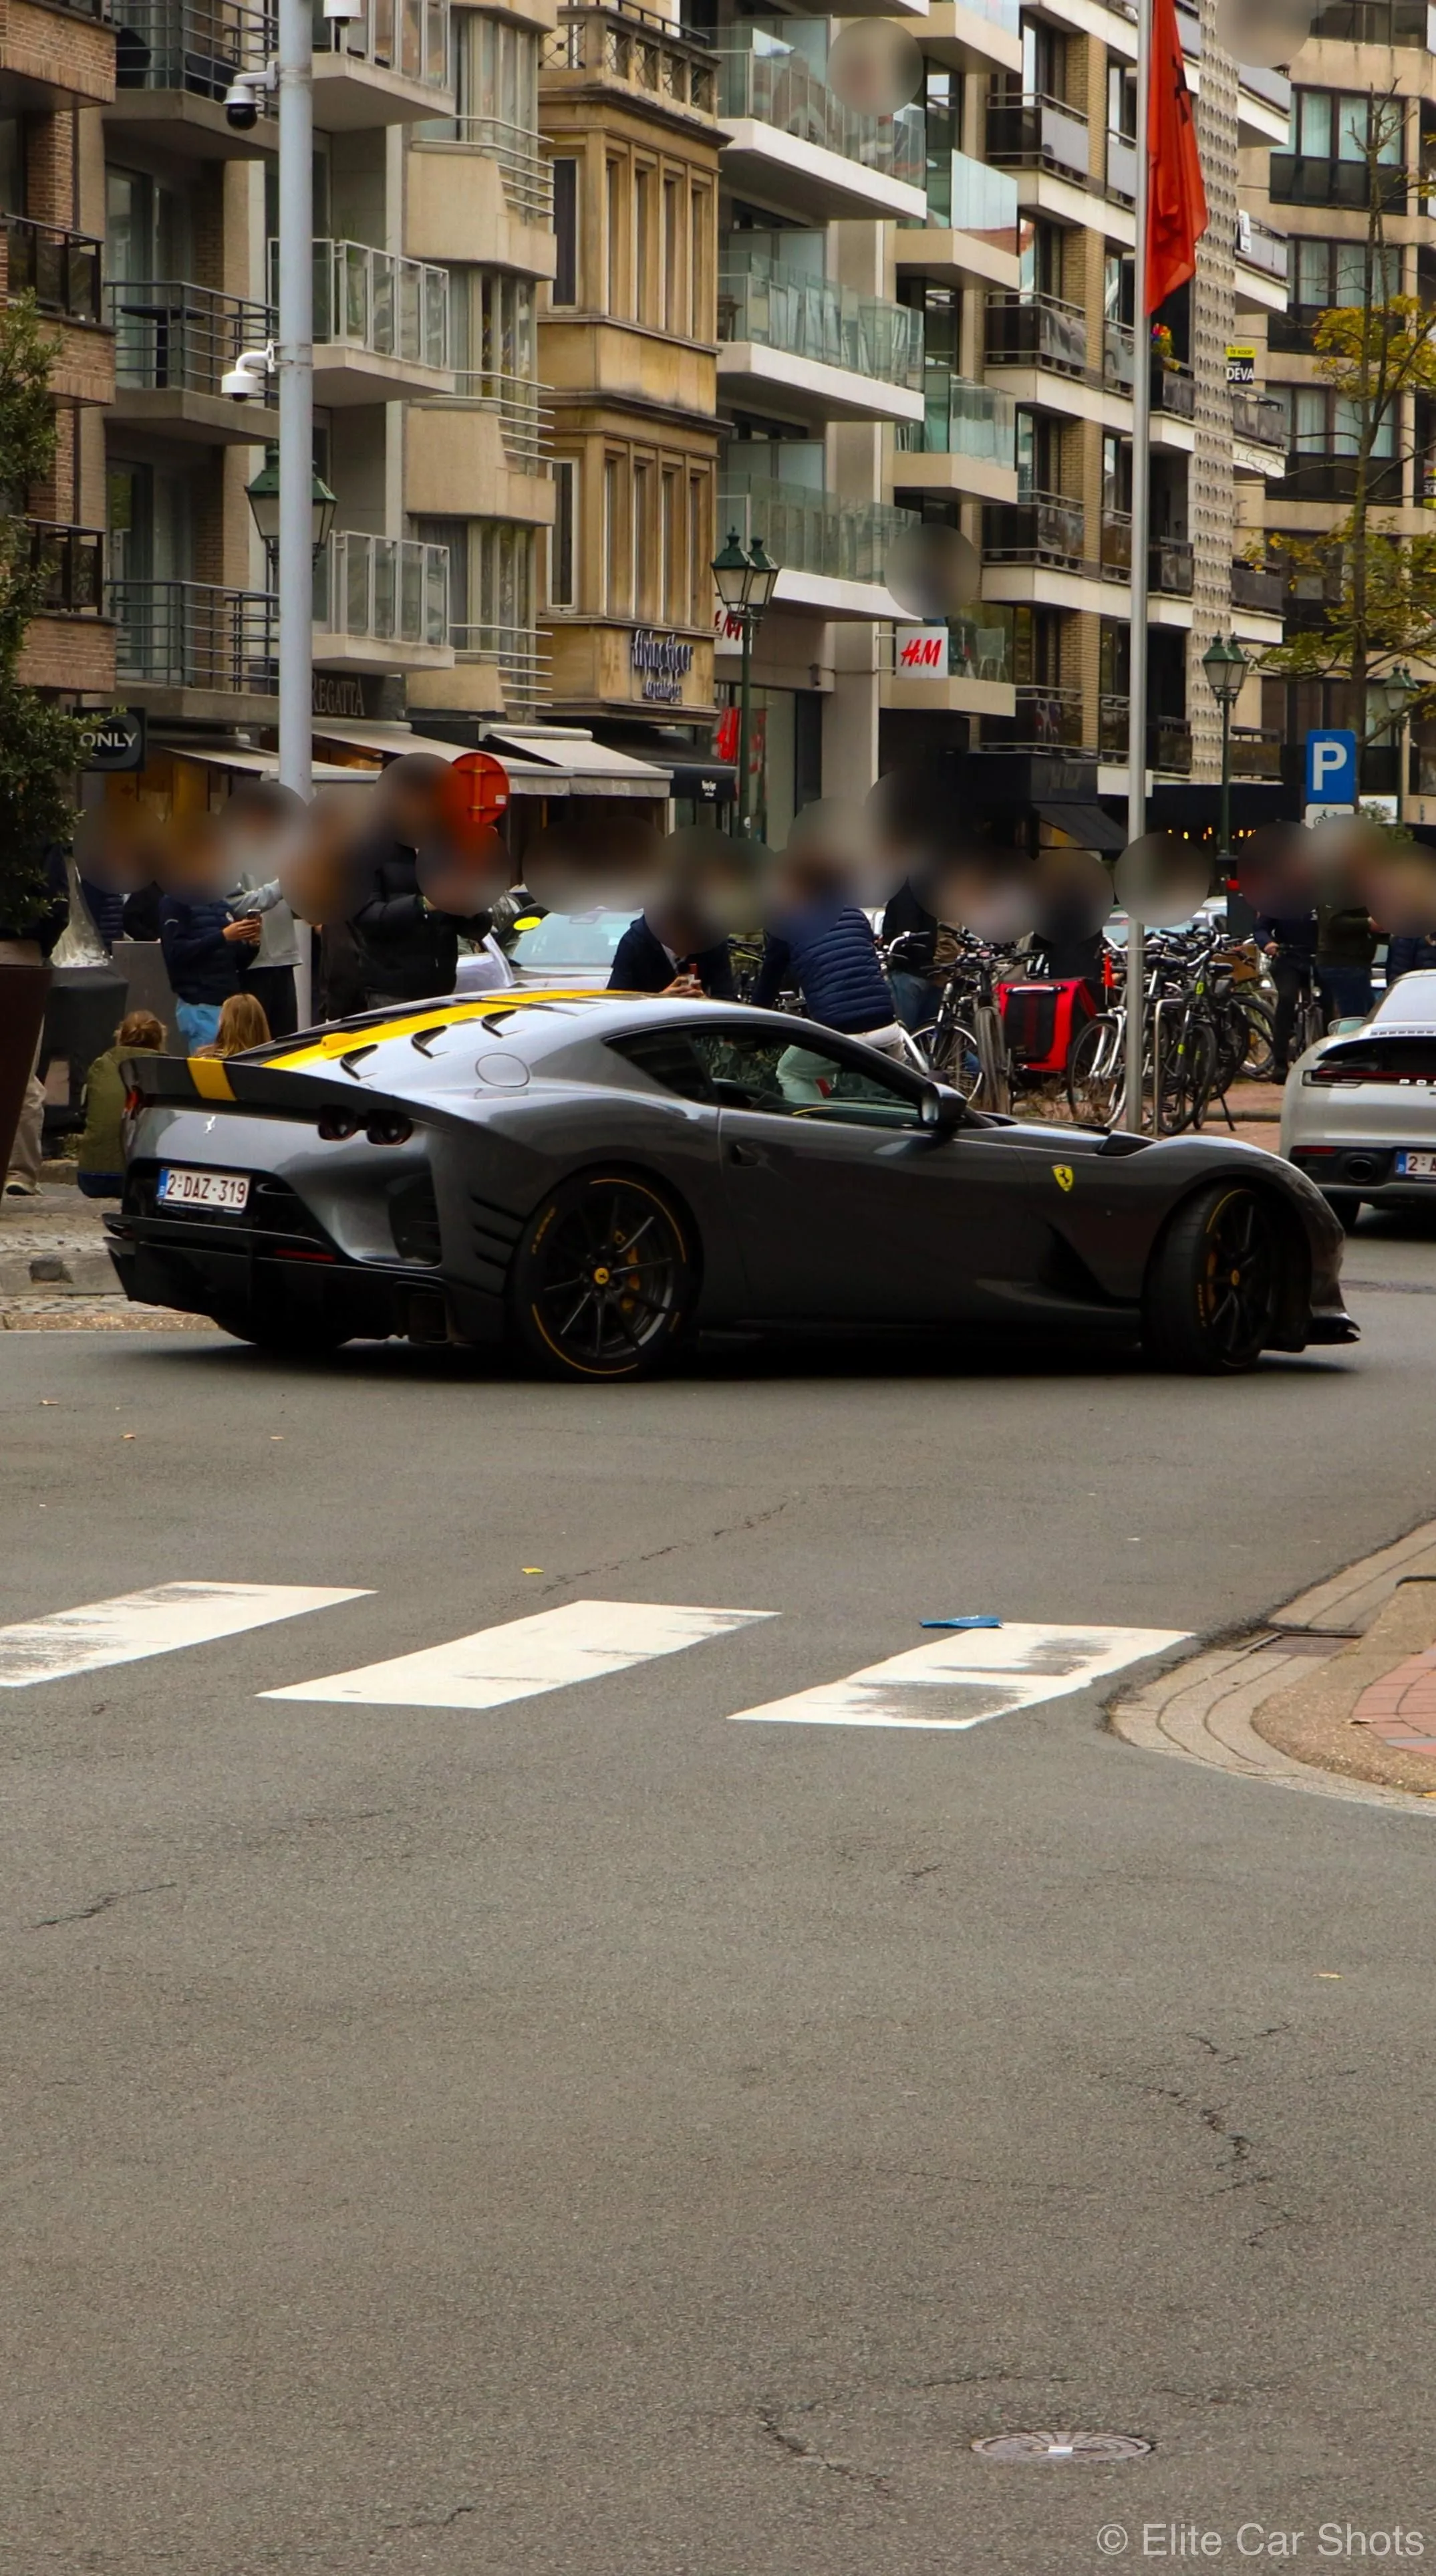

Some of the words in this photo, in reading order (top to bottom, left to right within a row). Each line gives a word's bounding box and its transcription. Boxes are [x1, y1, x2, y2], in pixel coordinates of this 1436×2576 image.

[1226, 367, 1254, 381] DEVA
[900, 638, 942, 667] H&M
[80, 732, 138, 747] ONLY
[1312, 741, 1348, 791] P
[166, 1174, 247, 1203] 2-DAZ-319
